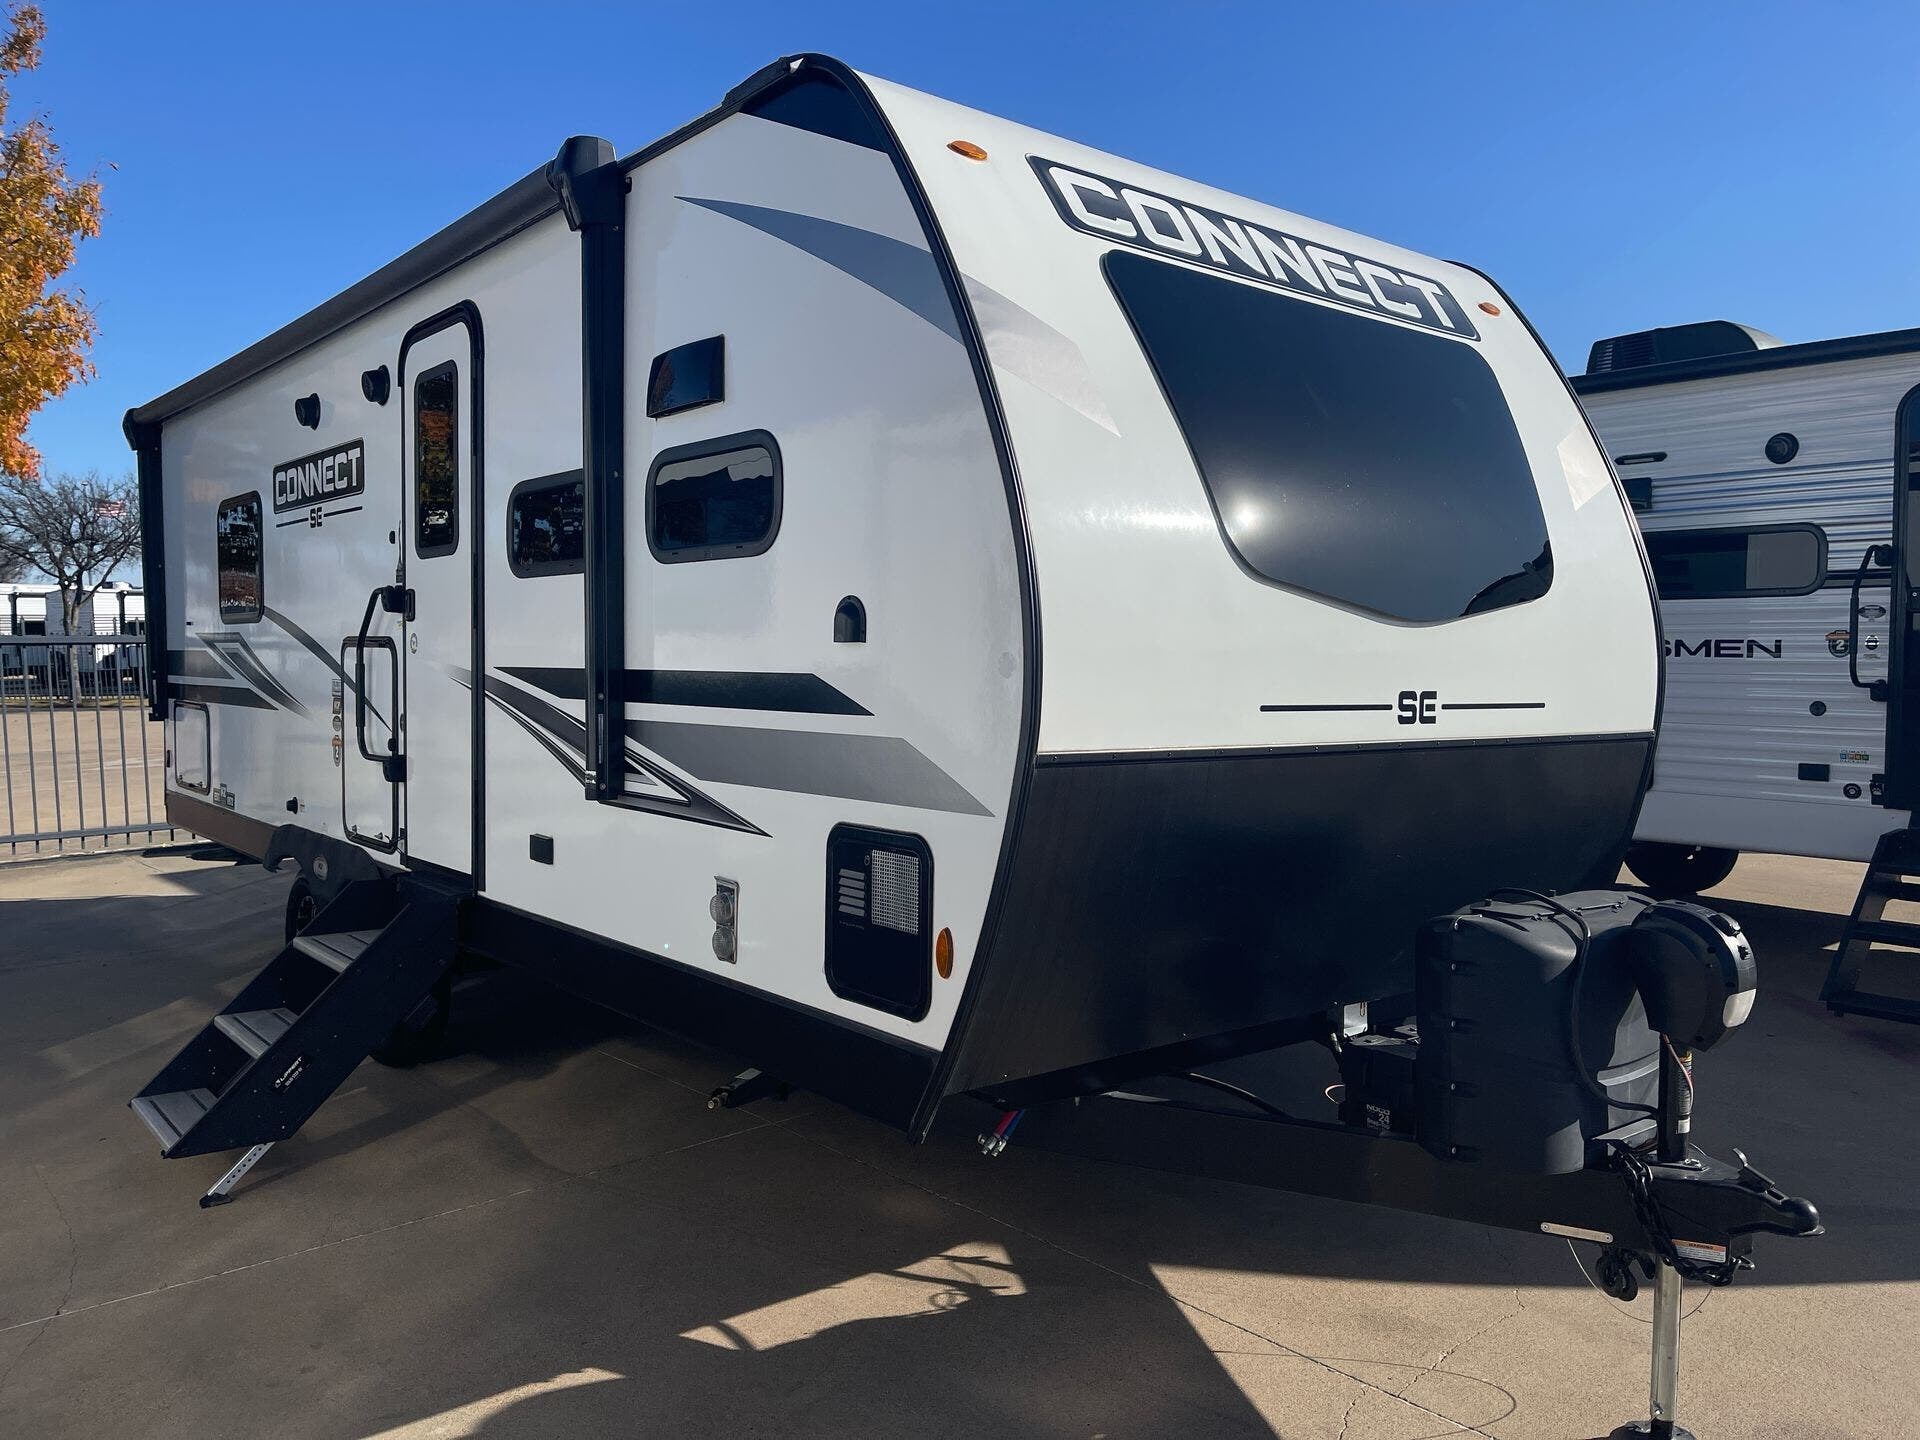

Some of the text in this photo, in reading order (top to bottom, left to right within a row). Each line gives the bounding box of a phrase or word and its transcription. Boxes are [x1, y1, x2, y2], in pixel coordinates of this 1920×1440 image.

[1048, 165, 1455, 328] CONNECT
[275, 447, 361, 506] CONNECT
[309, 506, 323, 529] SE
[1664, 639, 1782, 658] MEN
[1836, 639, 1845, 650] 2
[1397, 690, 1438, 725] SE
[1379, 1113, 1390, 1125] 24
